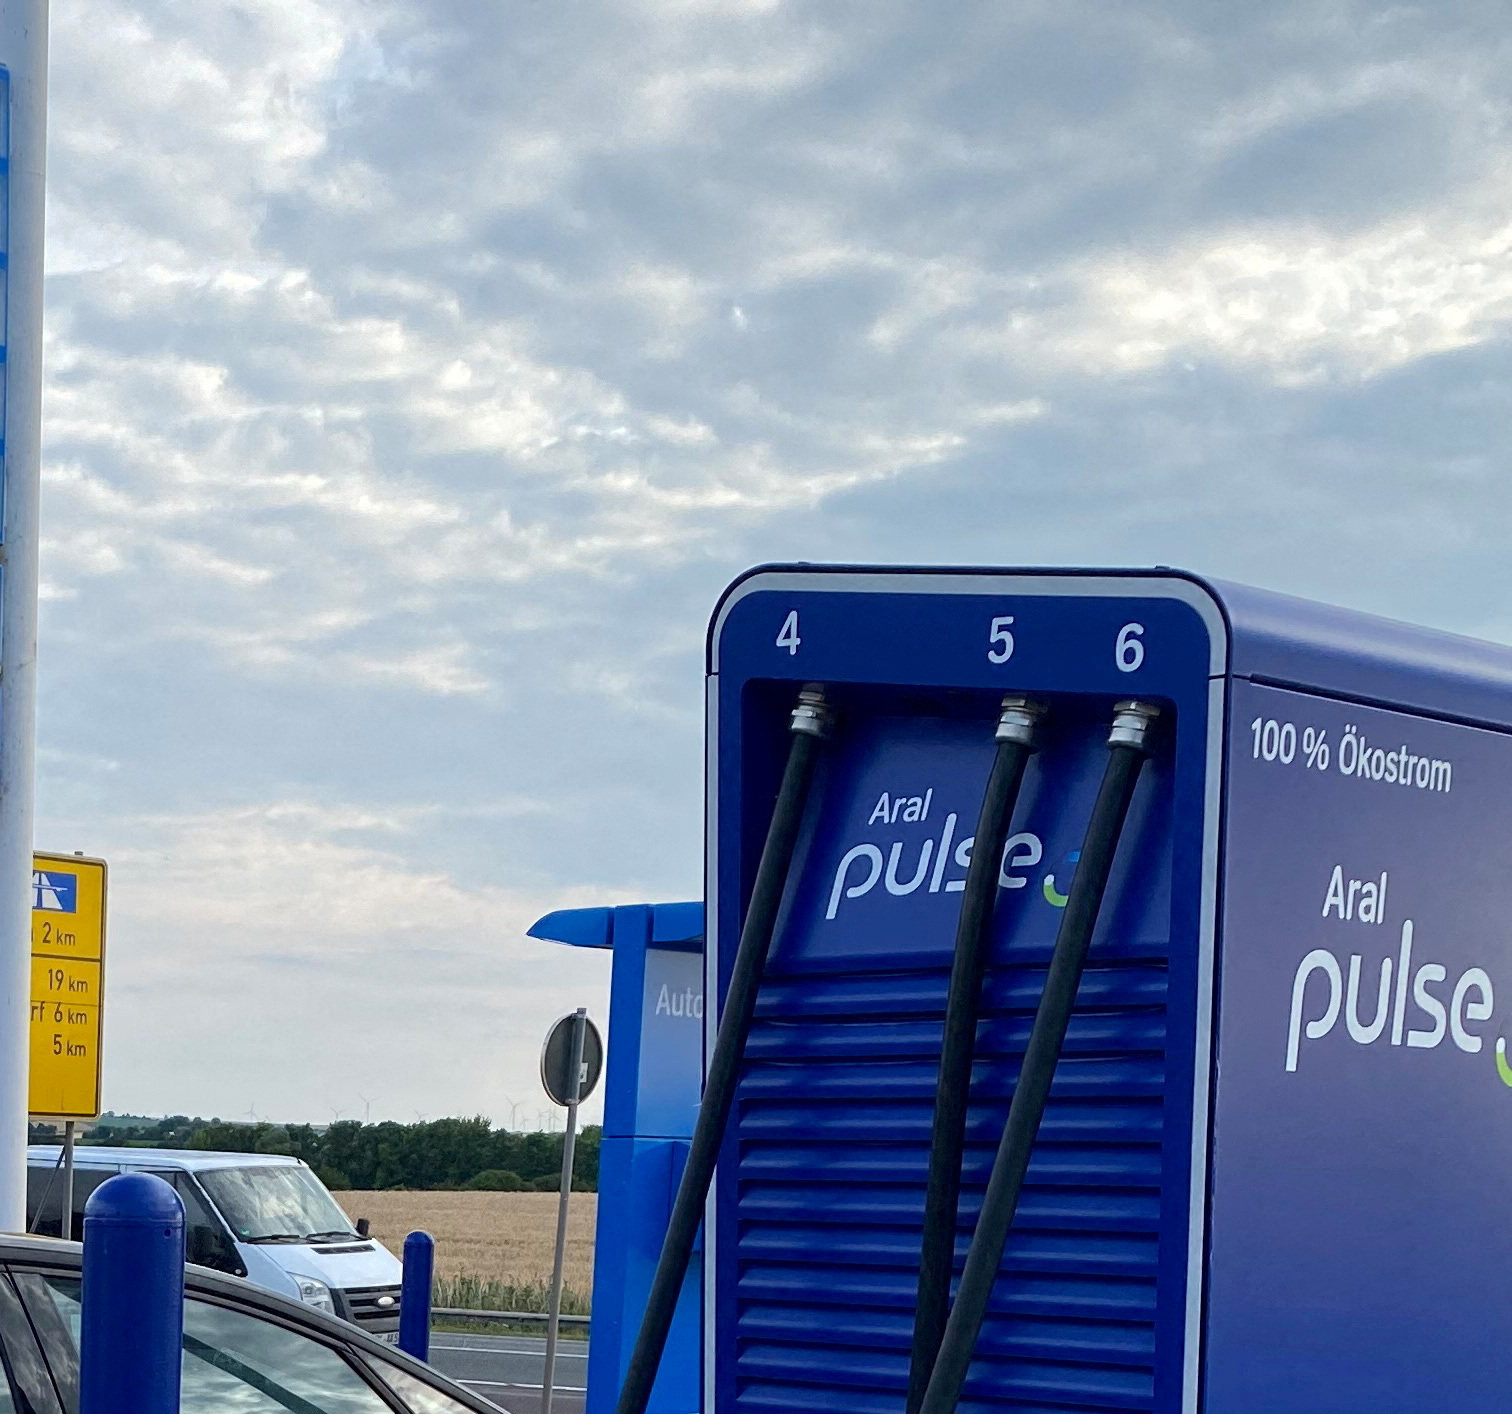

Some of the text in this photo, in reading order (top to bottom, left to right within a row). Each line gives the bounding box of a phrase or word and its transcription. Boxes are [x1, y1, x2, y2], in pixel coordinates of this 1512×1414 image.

[775, 610, 801, 656] 4
[988, 616, 1015, 665] 5
[1115, 622, 1145, 673] 6
[1251, 716, 1452, 793] 100 % Ökostrom
[868, 787, 933, 826] Aral
[1321, 864, 1388, 925] Aral
[42, 921, 76, 946] 2 km
[47, 968, 88, 993] 19 km
[1285, 919, 1494, 1073] pulse
[54, 1001, 63, 1023] 6
[68, 1008, 87, 1025] km
[53, 1033, 86, 1057] 5 km
